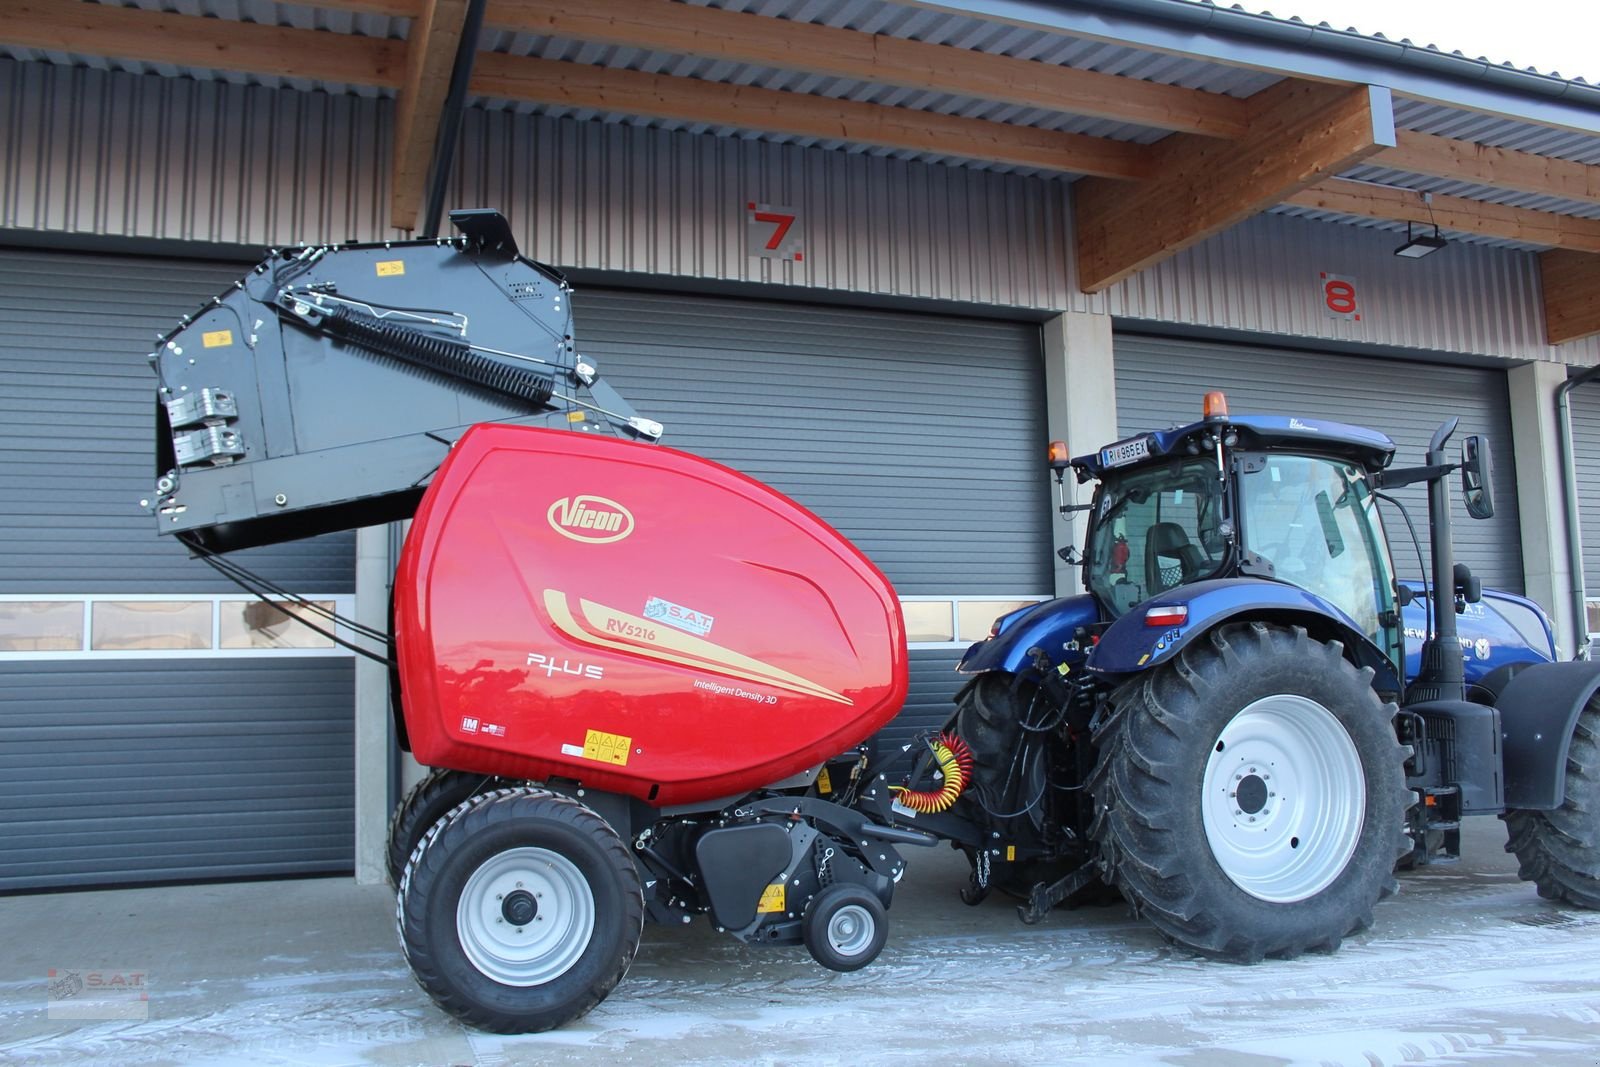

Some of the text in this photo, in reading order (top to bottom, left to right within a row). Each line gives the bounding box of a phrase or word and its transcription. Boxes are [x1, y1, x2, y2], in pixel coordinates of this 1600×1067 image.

[754, 212, 796, 250] 7
[1325, 280, 1356, 314] 8
[560, 496, 624, 532] Vicon
[606, 618, 656, 641] RV5216
[668, 605, 711, 629] S.A.T.
[693, 679, 778, 705] Intelligent Density 3D
